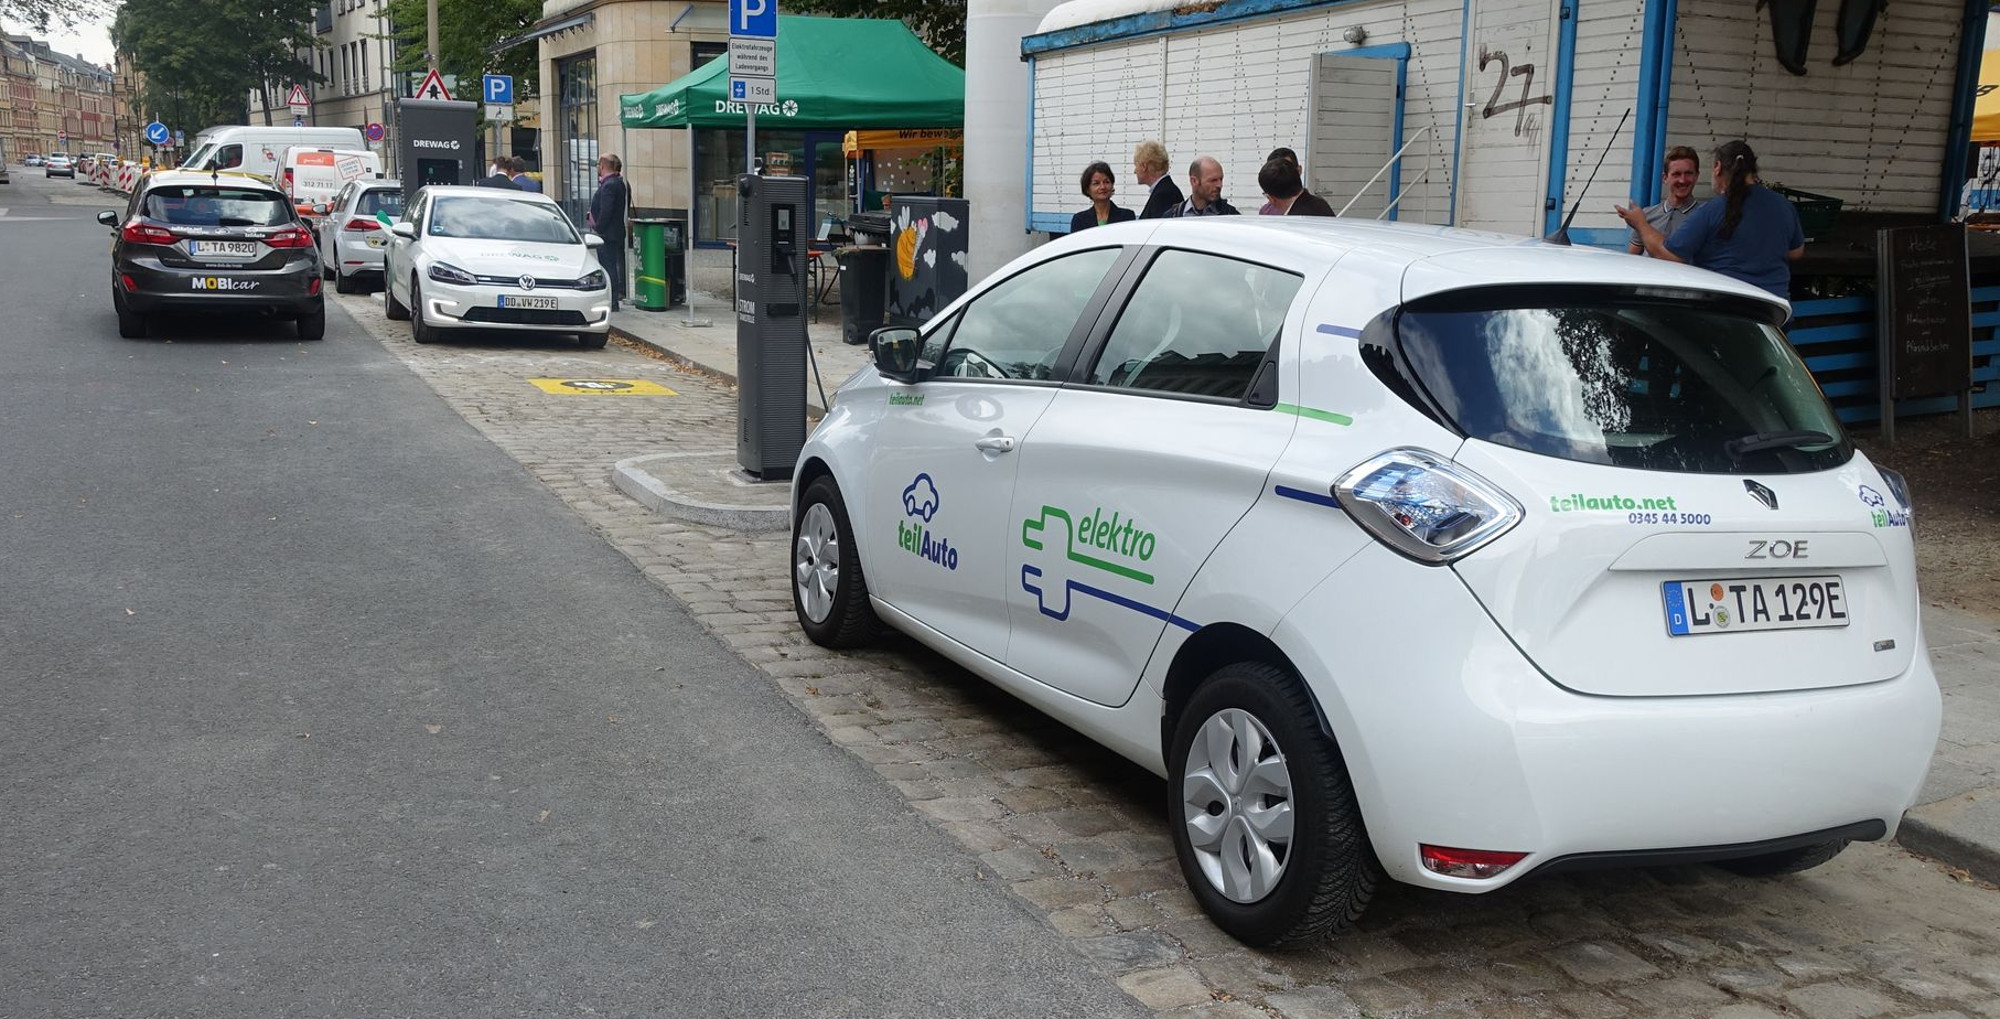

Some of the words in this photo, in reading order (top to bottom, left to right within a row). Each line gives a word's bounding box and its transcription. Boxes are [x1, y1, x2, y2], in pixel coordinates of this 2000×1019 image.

[741, 0, 766, 30] P
[731, 43, 773, 53] Elektrofahrzeuge
[735, 63, 769, 72] Ladevorgangs
[490, 78, 506, 100] P
[751, 86, 754, 95] 1
[755, 87, 771, 95] Std.
[1479, 47, 1552, 137] 27
[899, 129, 918, 139] Wir
[413, 139, 450, 150] DREWAG
[197, 241, 204, 252] L
[212, 241, 226, 252] TA
[228, 242, 255, 254] 9820
[191, 276, 260, 290] MOBIcar
[505, 297, 516, 307] DD
[522, 298, 533, 308] VW
[739, 299, 755, 314] STROM
[889, 393, 925, 406] teilauto.net
[1549, 493, 1677, 513] teilauto.net
[1628, 512, 1660, 525] 0345
[1661, 512, 1678, 525] 44
[1680, 512, 1711, 525] 5000
[1871, 508, 1906, 528] teilAuto
[1078, 507, 1156, 562] elektro
[898, 519, 958, 571] teilAuto
[1744, 540, 1809, 560] ZOE
[1687, 587, 1711, 626] L
[1729, 584, 1771, 623] TA
[1775, 581, 1846, 622] 129E
[1674, 614, 1682, 625] D
